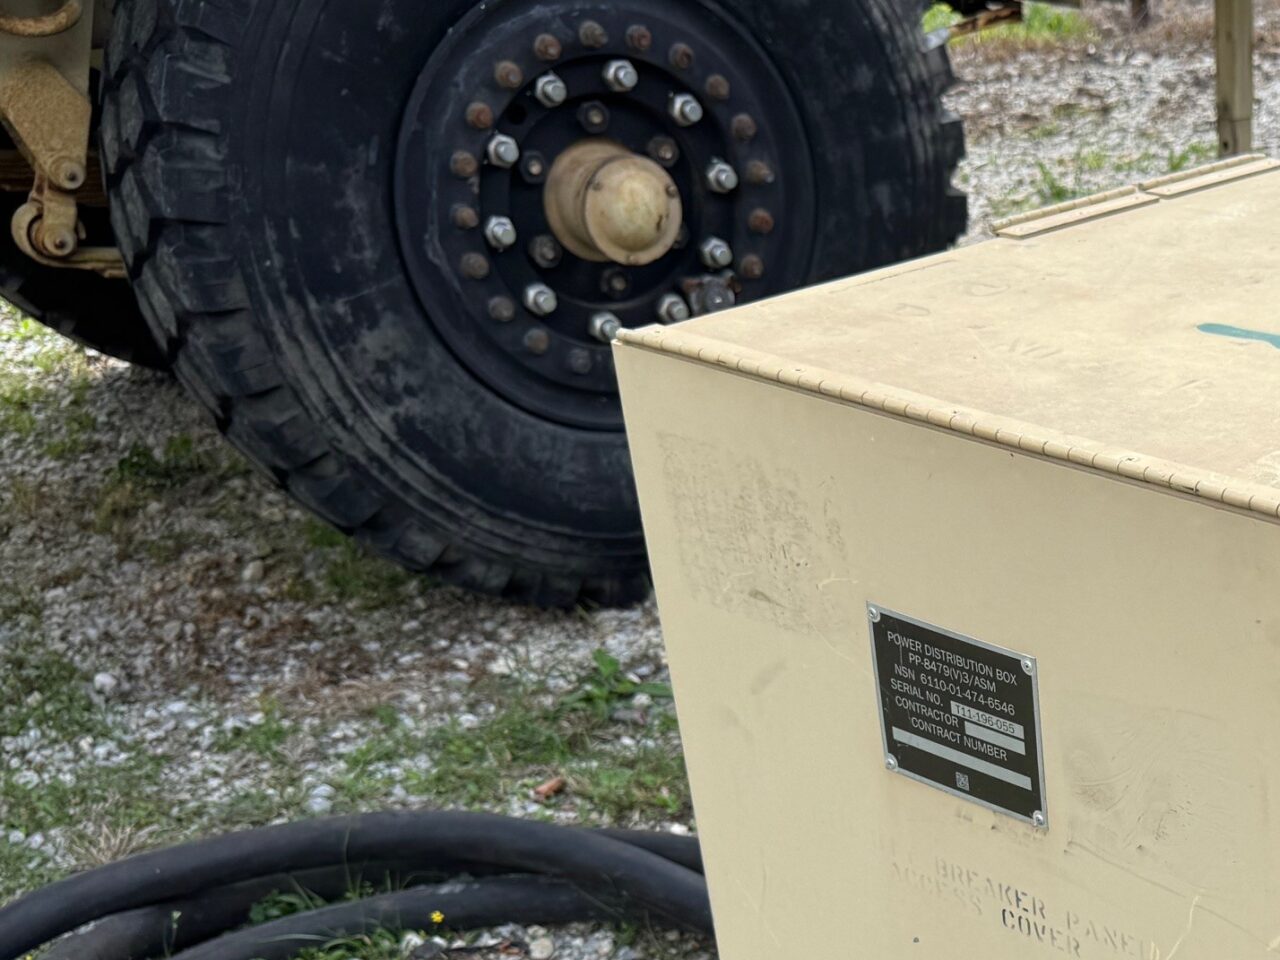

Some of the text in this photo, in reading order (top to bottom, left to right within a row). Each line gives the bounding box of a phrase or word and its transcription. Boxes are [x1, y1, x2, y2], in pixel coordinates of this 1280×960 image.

[887, 631, 1018, 686] POWER DISTRIBUTION BOX
[908, 653, 996, 693] PP-8479(V)3/ASM
[890, 678, 924, 700] SERIAL
[926, 691, 943, 707] NO.
[895, 663, 1015, 716] NSN 6110-01-474-6546
[895, 695, 959, 727] CONTRACTOR
[911, 717, 1008, 761] CONTRACT NUMBER
[935, 857, 1047, 920] BREAKER
[1001, 908, 1081, 958] COVER
